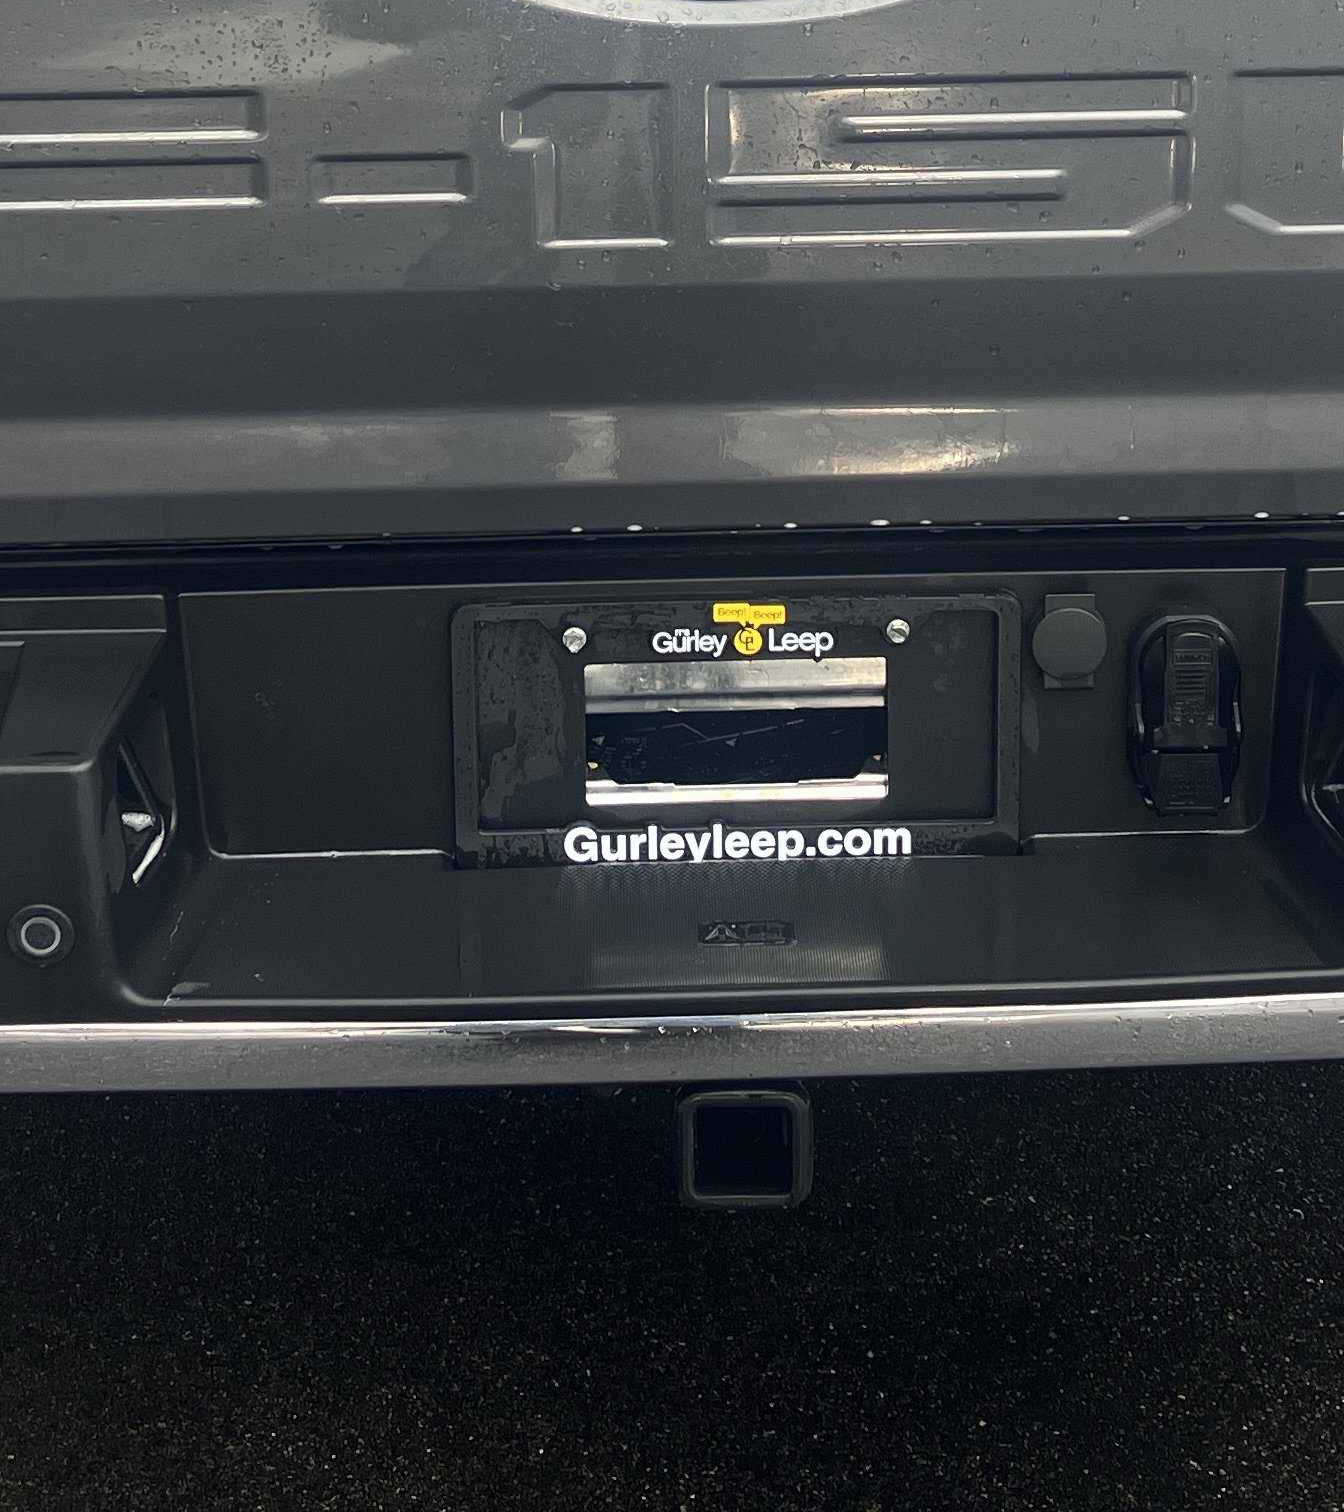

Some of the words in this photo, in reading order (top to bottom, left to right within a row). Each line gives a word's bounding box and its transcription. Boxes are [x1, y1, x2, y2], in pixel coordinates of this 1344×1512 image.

[717, 607, 747, 617] Beep!
[753, 610, 783, 620] Beep!
[652, 628, 728, 658] Gurley
[768, 628, 834, 658] Leep
[563, 822, 913, 863] Gurleyleep.com
